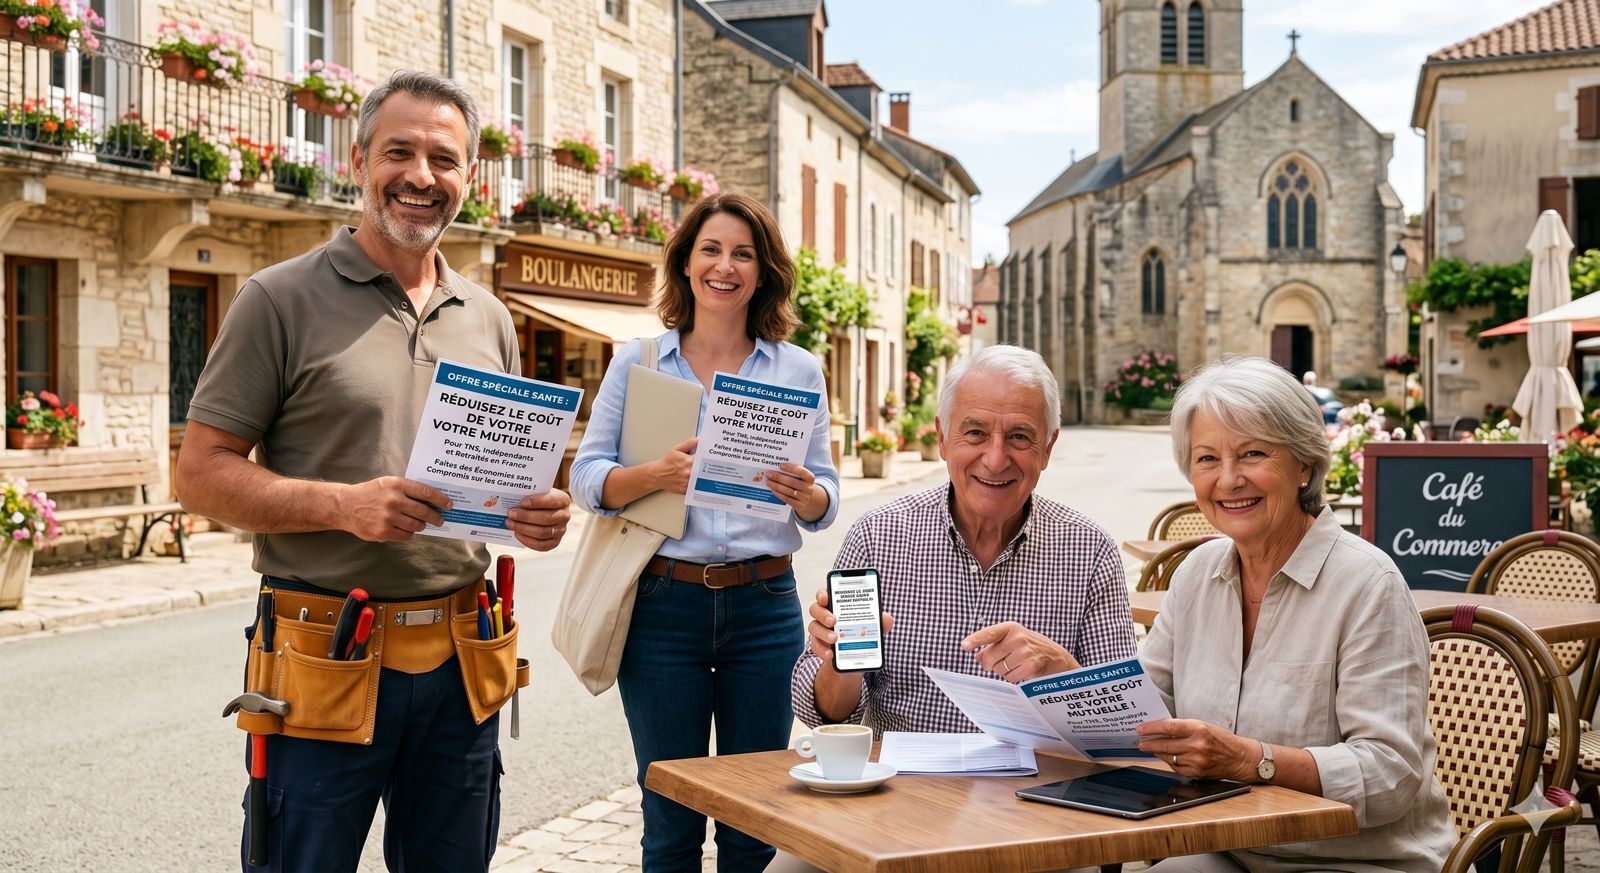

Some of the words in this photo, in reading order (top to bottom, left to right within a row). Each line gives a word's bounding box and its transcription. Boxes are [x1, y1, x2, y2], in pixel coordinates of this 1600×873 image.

[521, 255, 638, 296] BOULANGERIE
[447, 372, 480, 387] OFFRE
[482, 380, 530, 398] SPÉCIALE
[721, 381, 746, 391] OFFRE
[747, 386, 783, 399] SPÉCIALE
[440, 392, 505, 416] RÉDUISEZ
[509, 407, 524, 420] LE
[527, 410, 564, 427] COÛT
[716, 396, 765, 412] RÉDUISEZ
[767, 406, 779, 415] LE
[781, 409, 808, 420] COÛT
[735, 410, 749, 419] DE
[751, 413, 783, 425] VOTRE
[433, 418, 477, 438] VOTRE
[480, 430, 549, 451] MUTUELLE
[550, 443, 556, 452] !
[466, 413, 486, 426] DE
[489, 417, 532, 435] VOTRE
[712, 415, 745, 428] VOTRE
[747, 422, 798, 438] MUTUELLE
[444, 439, 463, 448] Pour
[464, 443, 481, 453] TNS,
[483, 447, 534, 462] Indépendants
[763, 443, 783, 451] France
[434, 458, 458, 469] Faites
[459, 463, 473, 472] des
[474, 466, 515, 480] Économies
[455, 451, 489, 463] Retraités
[501, 459, 527, 469] France
[426, 466, 470, 480] Compromis
[471, 475, 483, 483] sur
[484, 476, 496, 485] les
[497, 480, 532, 490] Garanties
[1422, 472, 1485, 507] Café
[1438, 506, 1466, 527] du
[1032, 681, 1060, 692] OFFRE
[1060, 673, 1101, 687] SPÉCIALE
[1039, 690, 1094, 706] RÉDUISEZ
[1095, 687, 1109, 696] LE
[1111, 679, 1143, 692] COÛT
[1067, 701, 1084, 710] DE
[1084, 693, 1124, 707] VOTRE
[1067, 703, 1129, 718] MUTUELLE
